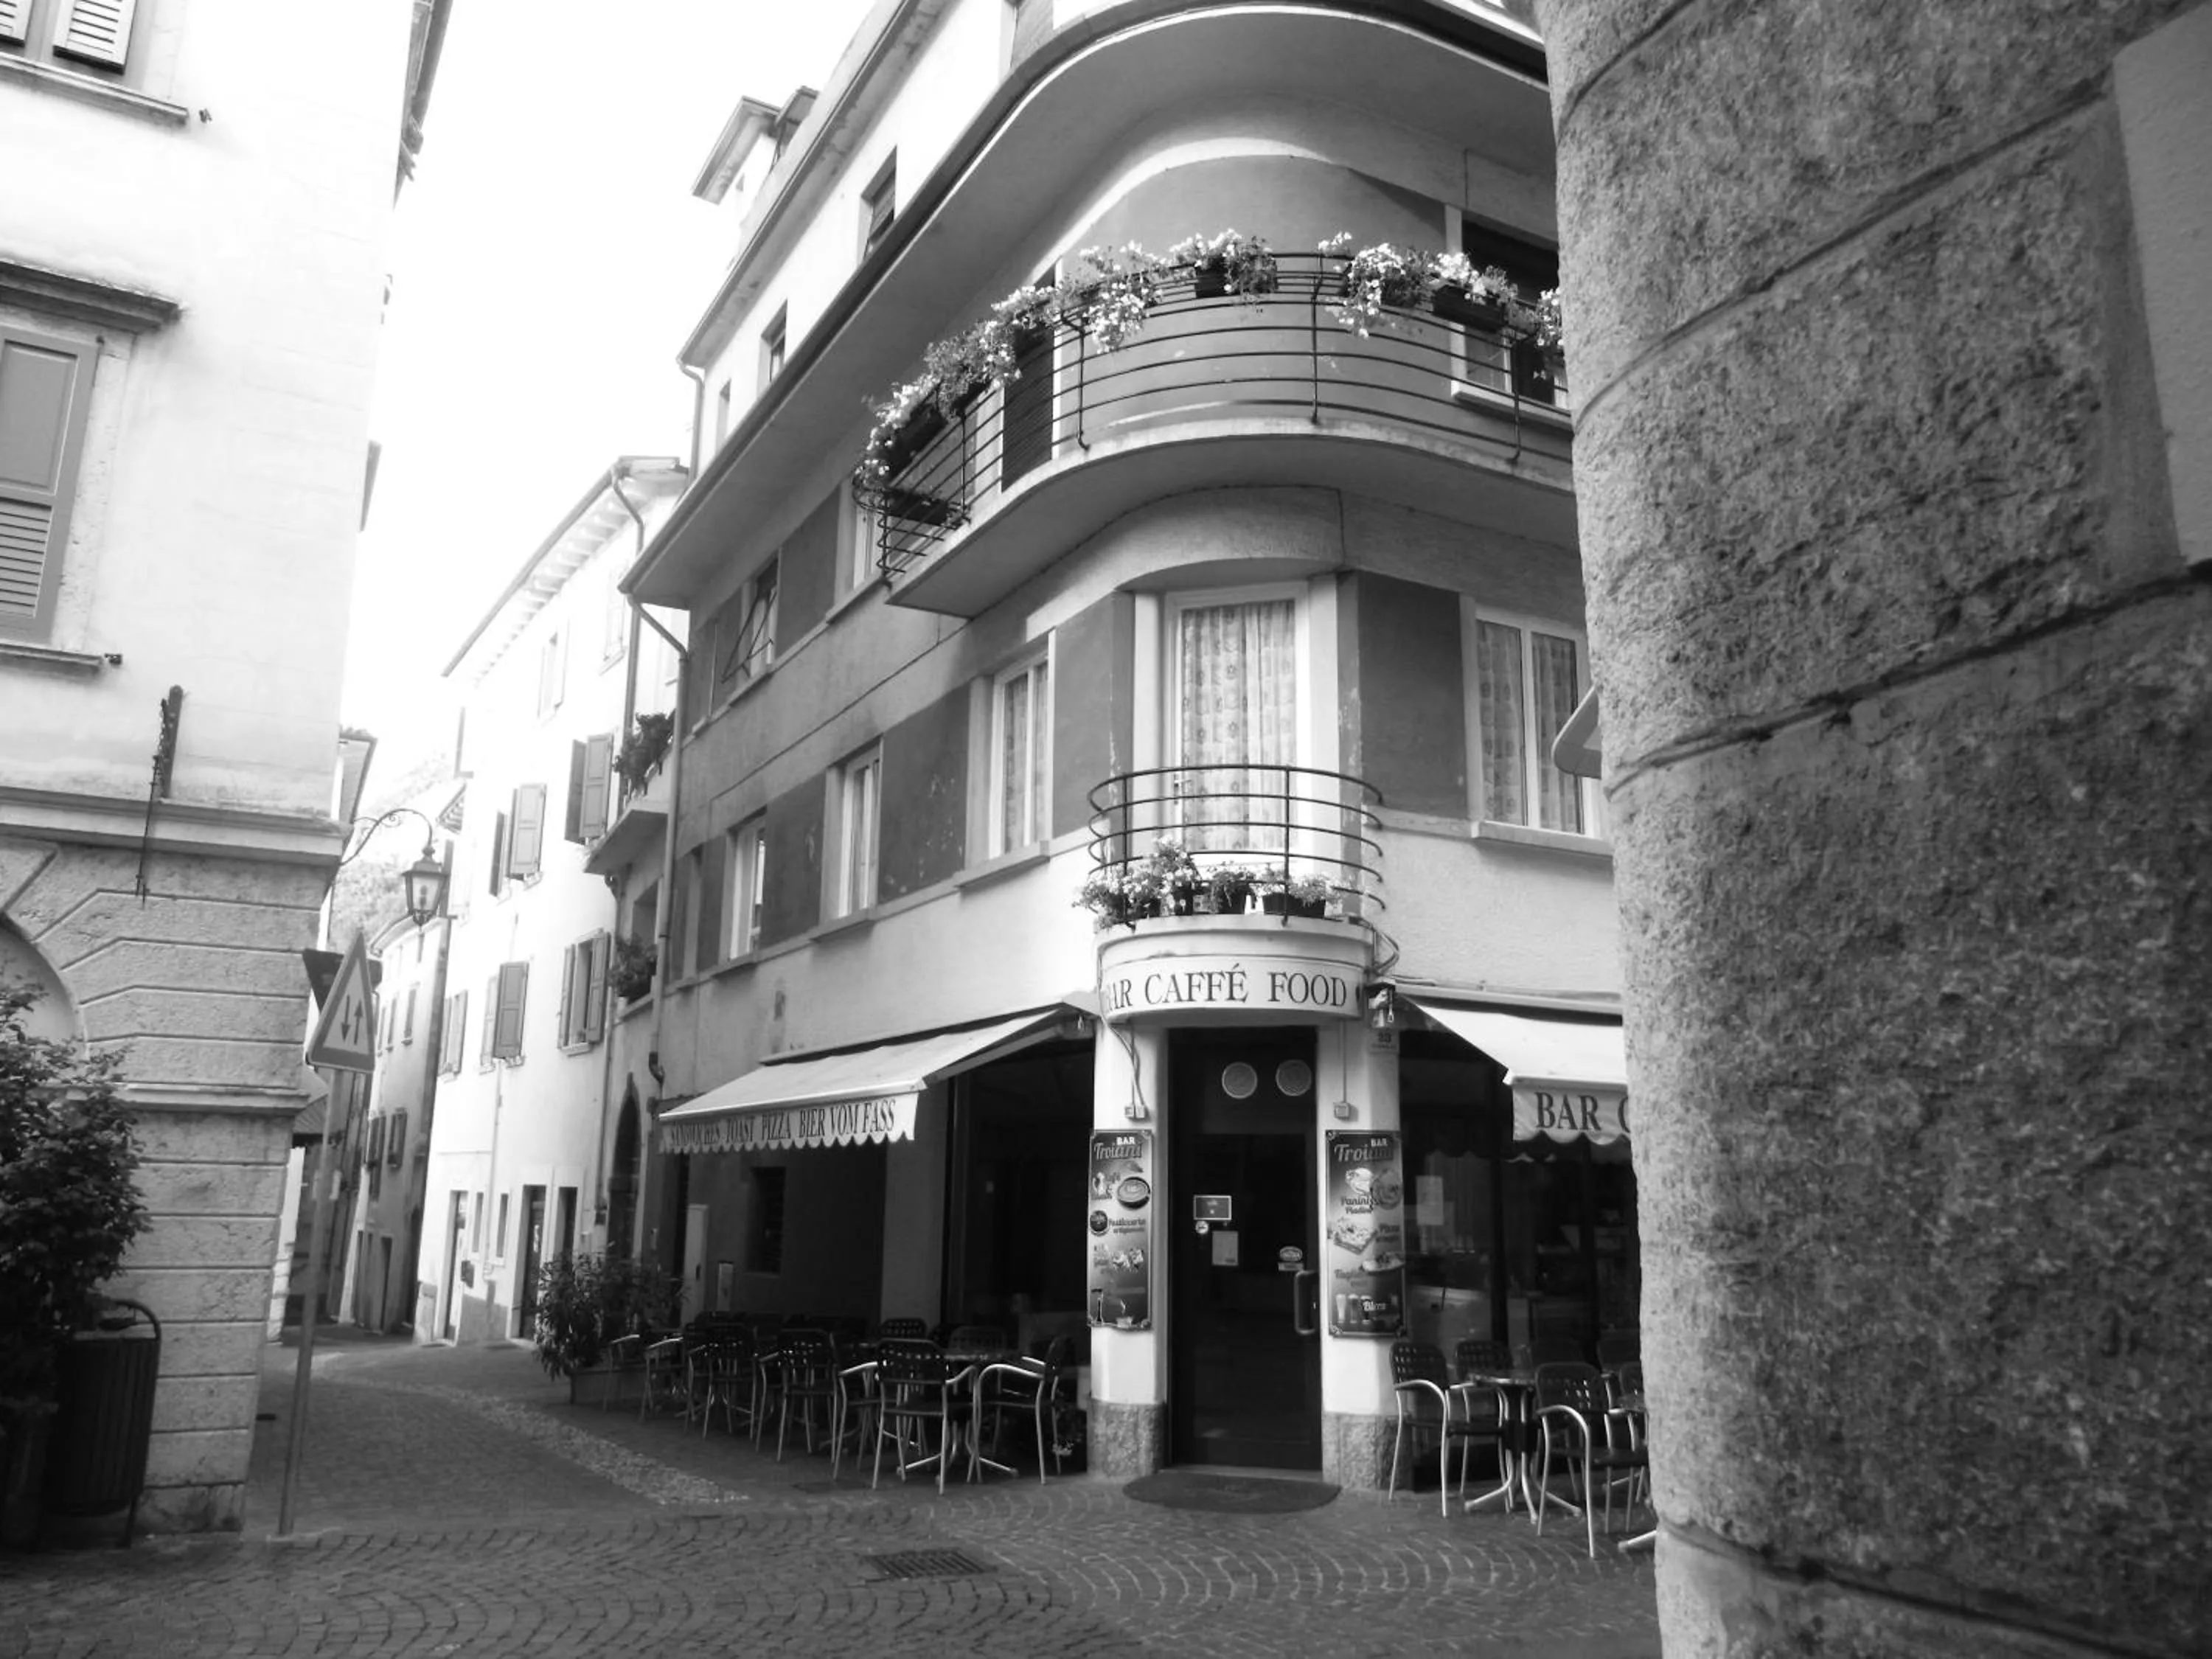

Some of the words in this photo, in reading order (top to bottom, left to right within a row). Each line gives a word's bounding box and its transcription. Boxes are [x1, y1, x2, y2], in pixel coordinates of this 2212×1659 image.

[1144, 963, 1248, 1004] CAFFÉ
[1267, 971, 1347, 1006] FOOD
[727, 1116, 754, 1142] TOAST
[762, 1111, 790, 1139] PIZZA
[799, 1108, 825, 1138] BIER
[830, 1104, 858, 1135] VOM
[862, 1099, 896, 1133] FASS
[1534, 1092, 1601, 1131] BAR
[1093, 1142, 1143, 1160] Troiani
[1116, 1136, 1135, 1145] BAR
[1371, 1138, 1388, 1147] BAR
